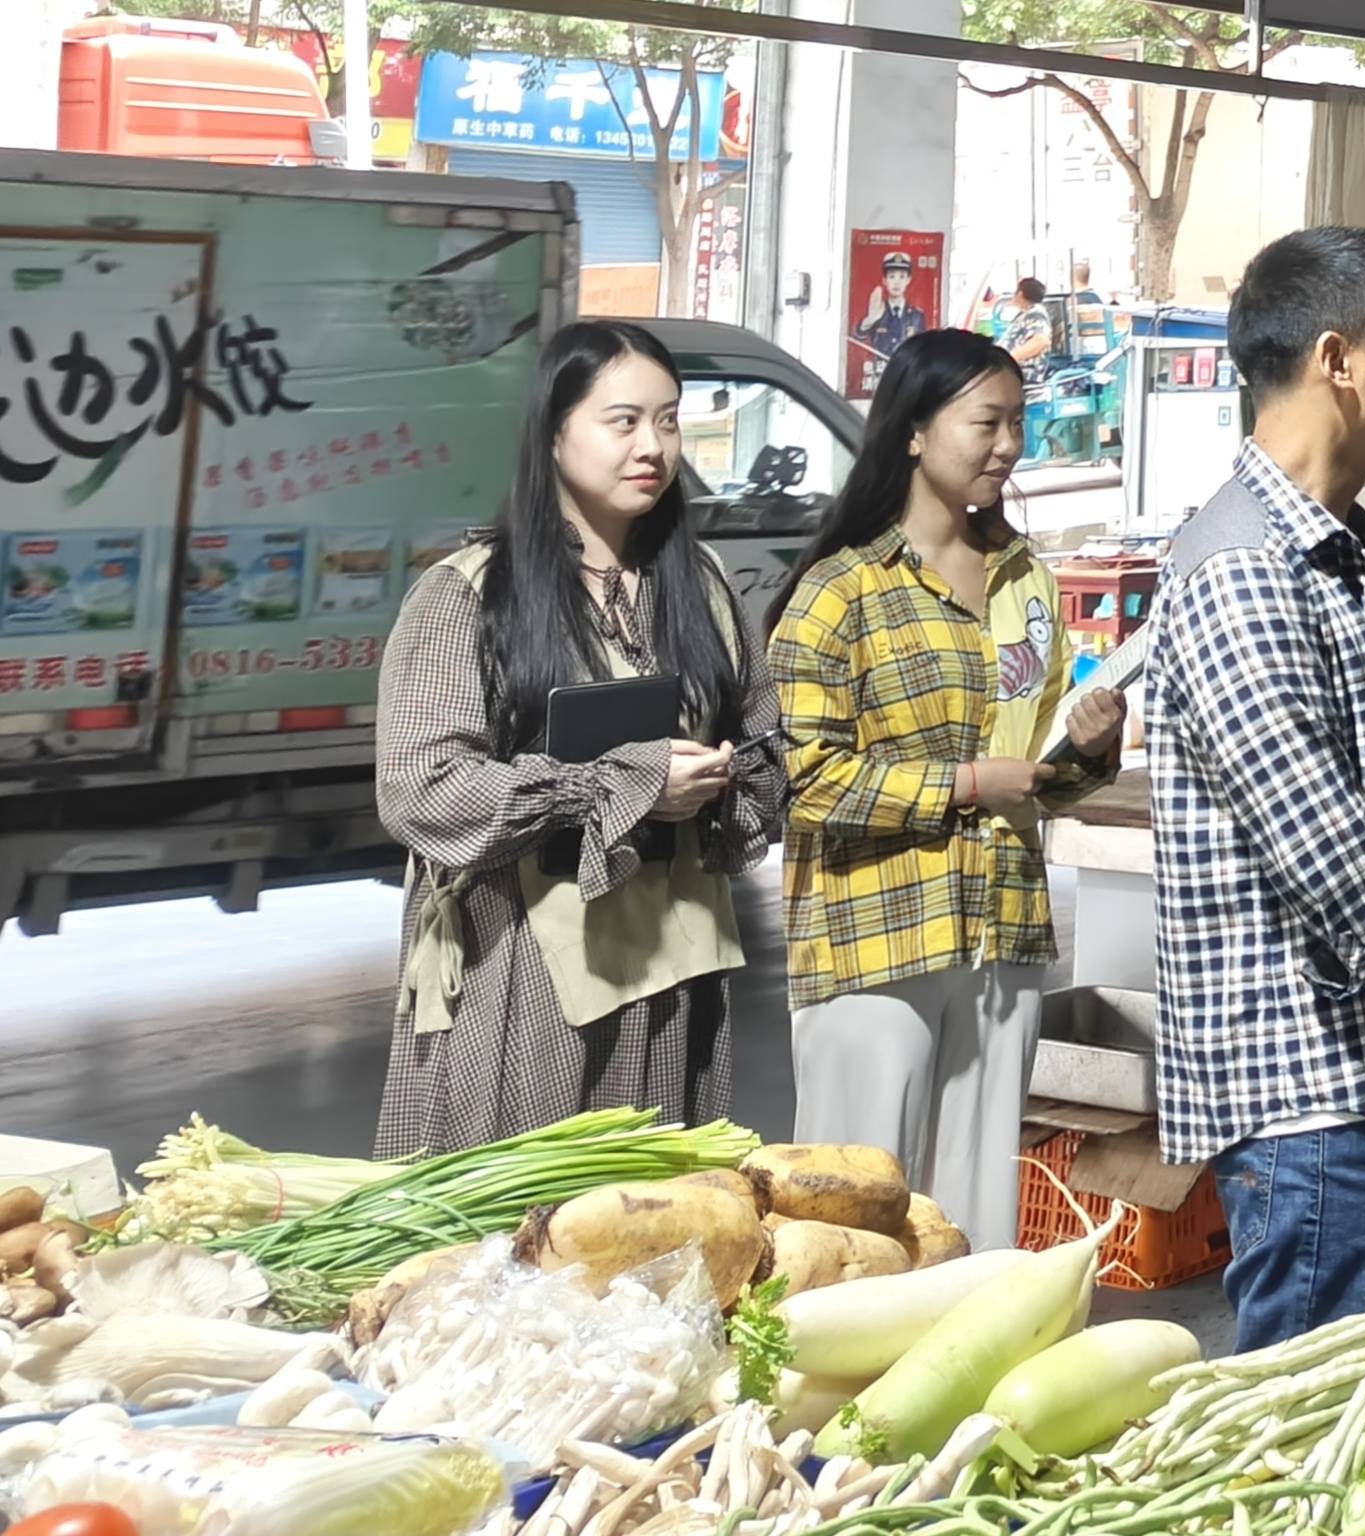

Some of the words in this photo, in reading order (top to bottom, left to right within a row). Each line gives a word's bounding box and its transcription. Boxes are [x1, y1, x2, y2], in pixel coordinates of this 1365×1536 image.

[0, 315, 315, 483] 边水饺
[188, 634, 388, 679] 0816-533
